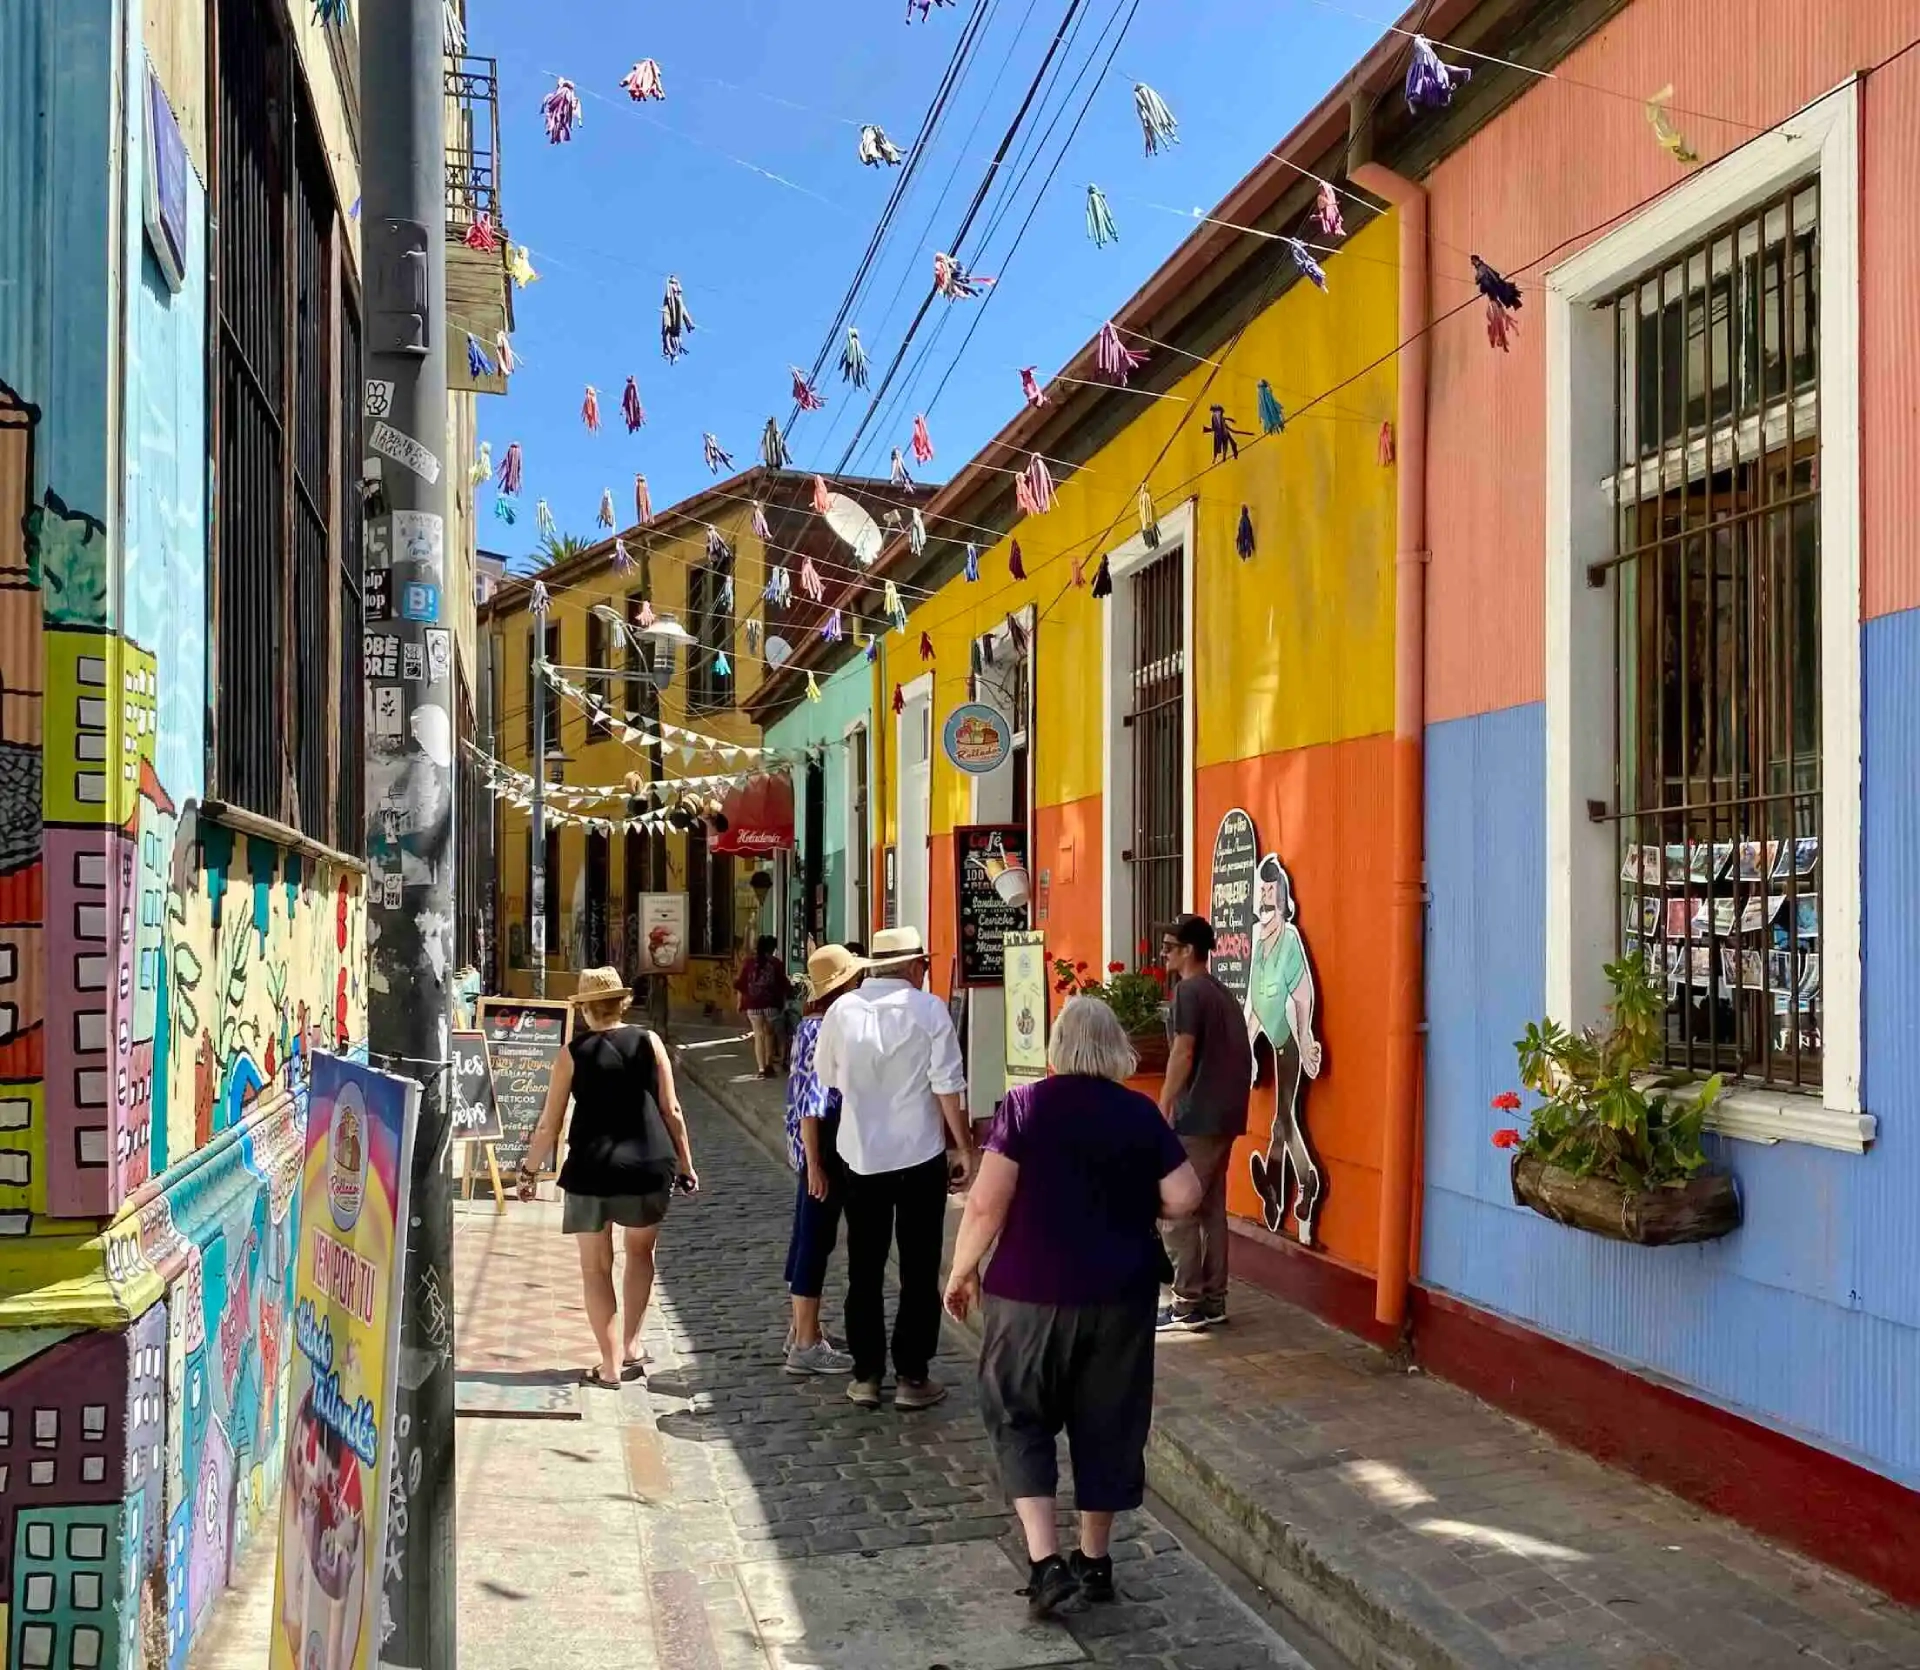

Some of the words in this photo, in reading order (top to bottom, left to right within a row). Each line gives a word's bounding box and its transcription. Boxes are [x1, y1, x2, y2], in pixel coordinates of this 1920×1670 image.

[494, 1009, 537, 1033] Café
[332, 1244, 355, 1312] POR
[359, 1258, 376, 1325] TU
[297, 1298, 333, 1372] Helado
[312, 1368, 377, 1468] Tailandés
